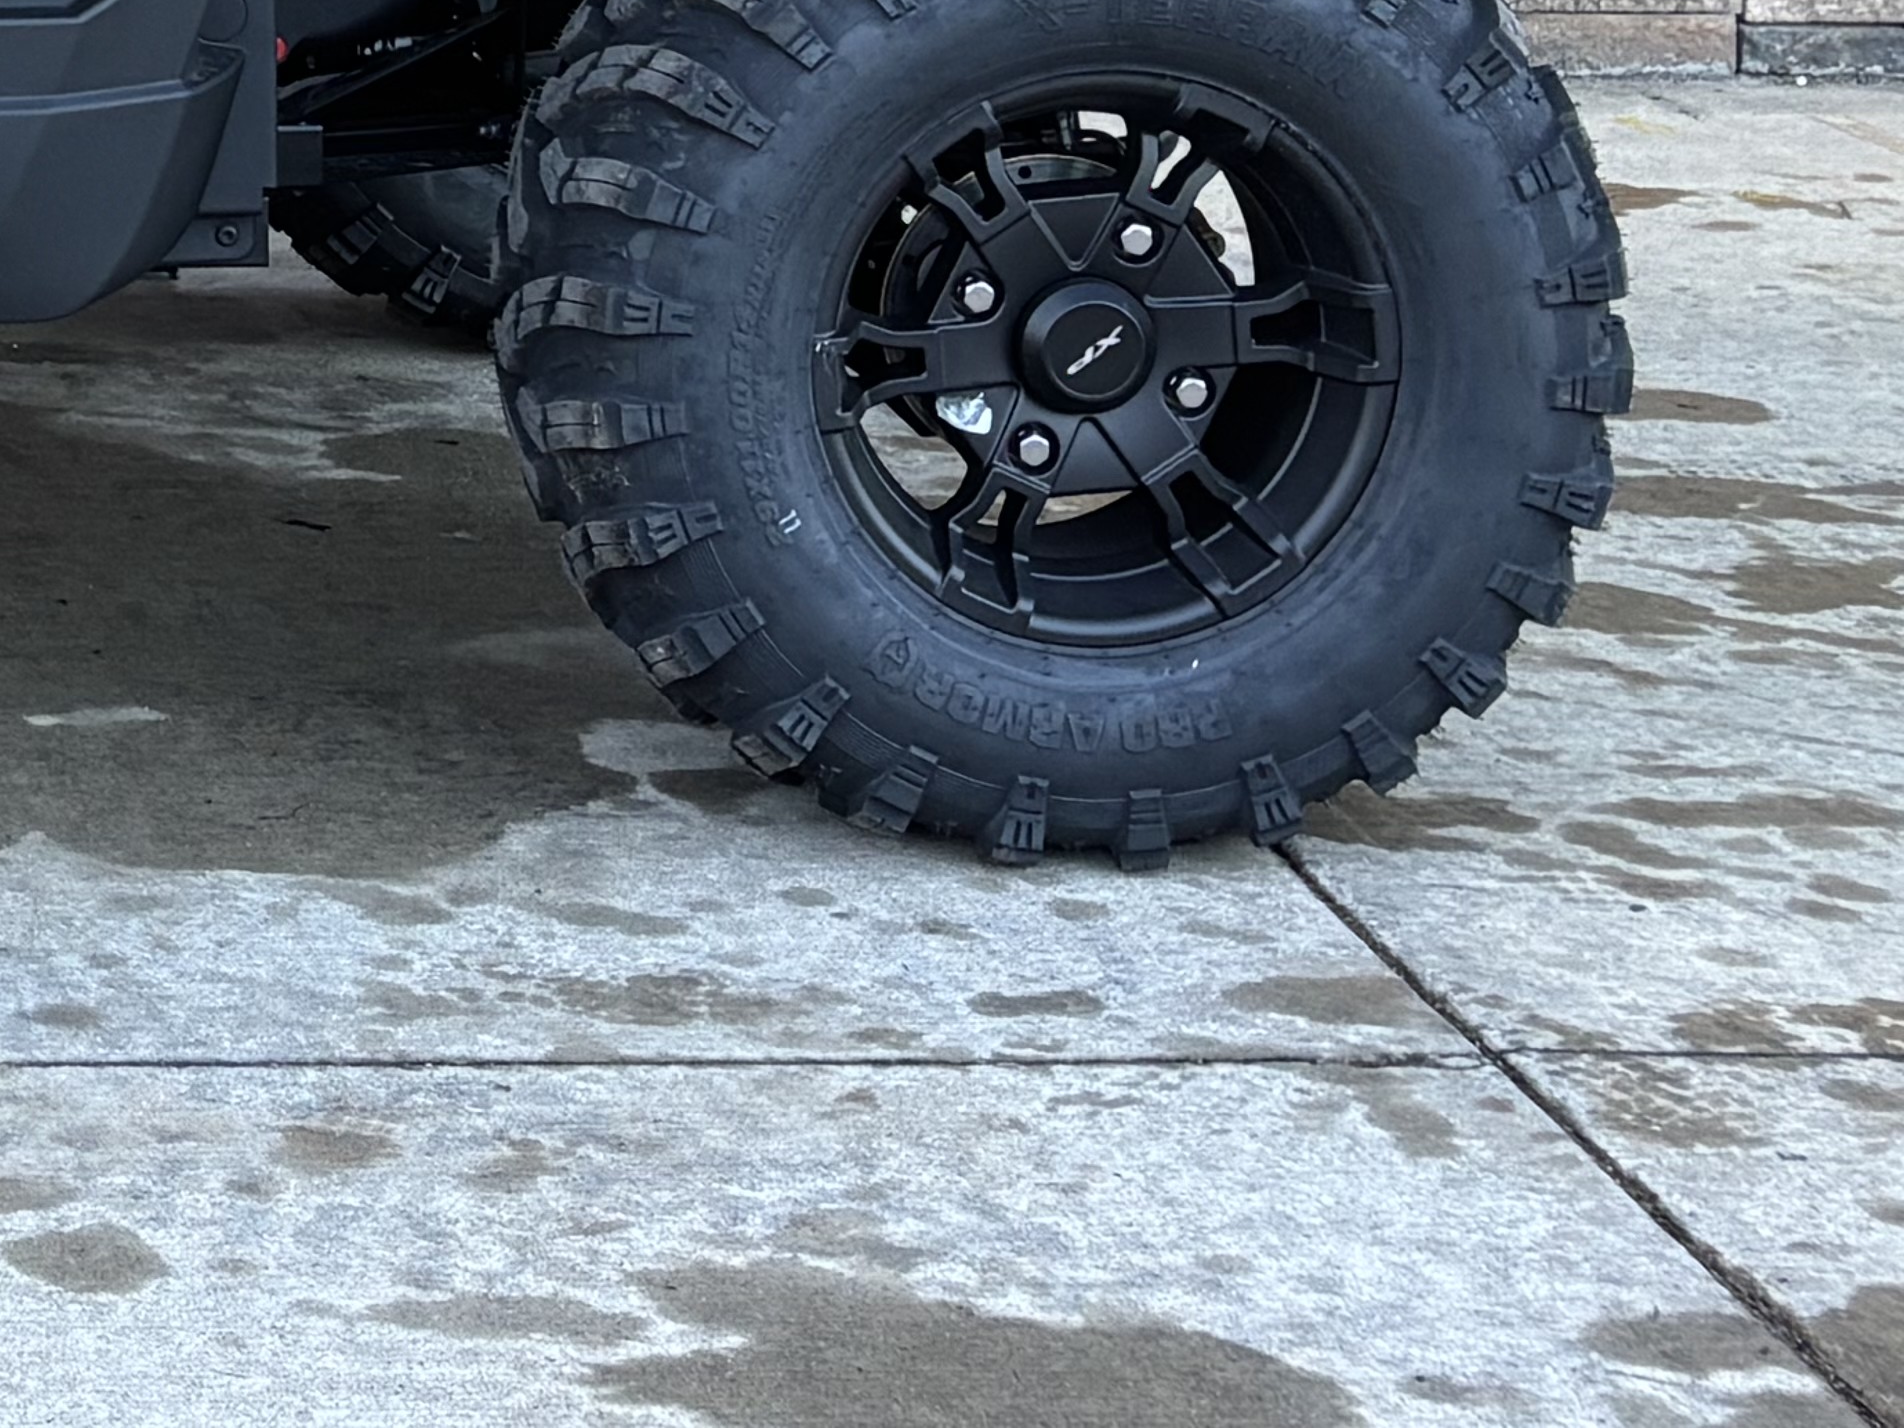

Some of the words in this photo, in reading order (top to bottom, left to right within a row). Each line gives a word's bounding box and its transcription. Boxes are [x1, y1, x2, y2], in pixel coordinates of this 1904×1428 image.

[1066, 325, 1123, 375] XP
[912, 668, 1107, 754] ARMOR
[1118, 694, 1234, 754] PRO
